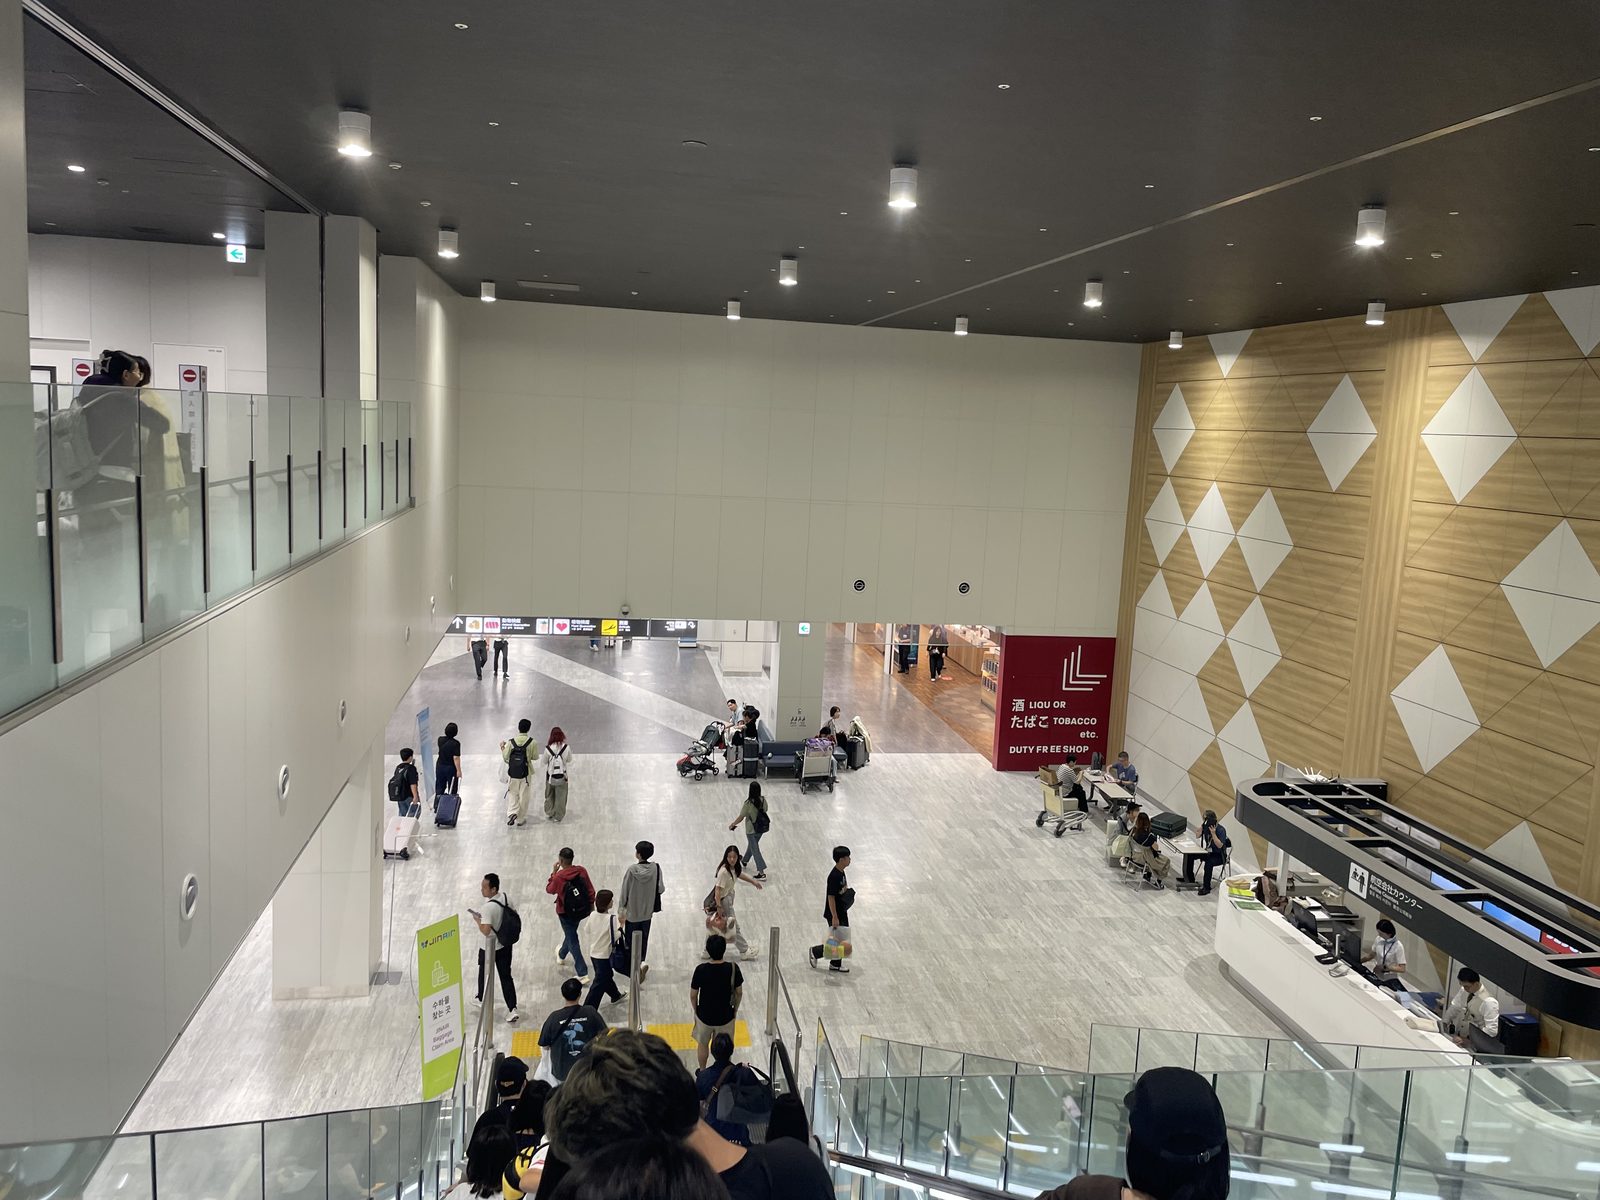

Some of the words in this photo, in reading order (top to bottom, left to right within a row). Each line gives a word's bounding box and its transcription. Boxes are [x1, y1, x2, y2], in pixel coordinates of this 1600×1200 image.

[1011, 698, 1025, 712] 酒
[1010, 714, 1049, 729] たばこ
[1052, 717, 1097, 726] TOBACCO
[1079, 730, 1099, 739] etc.
[1009, 745, 1036, 754] DUTY
[1062, 745, 1090, 754] SHOP
